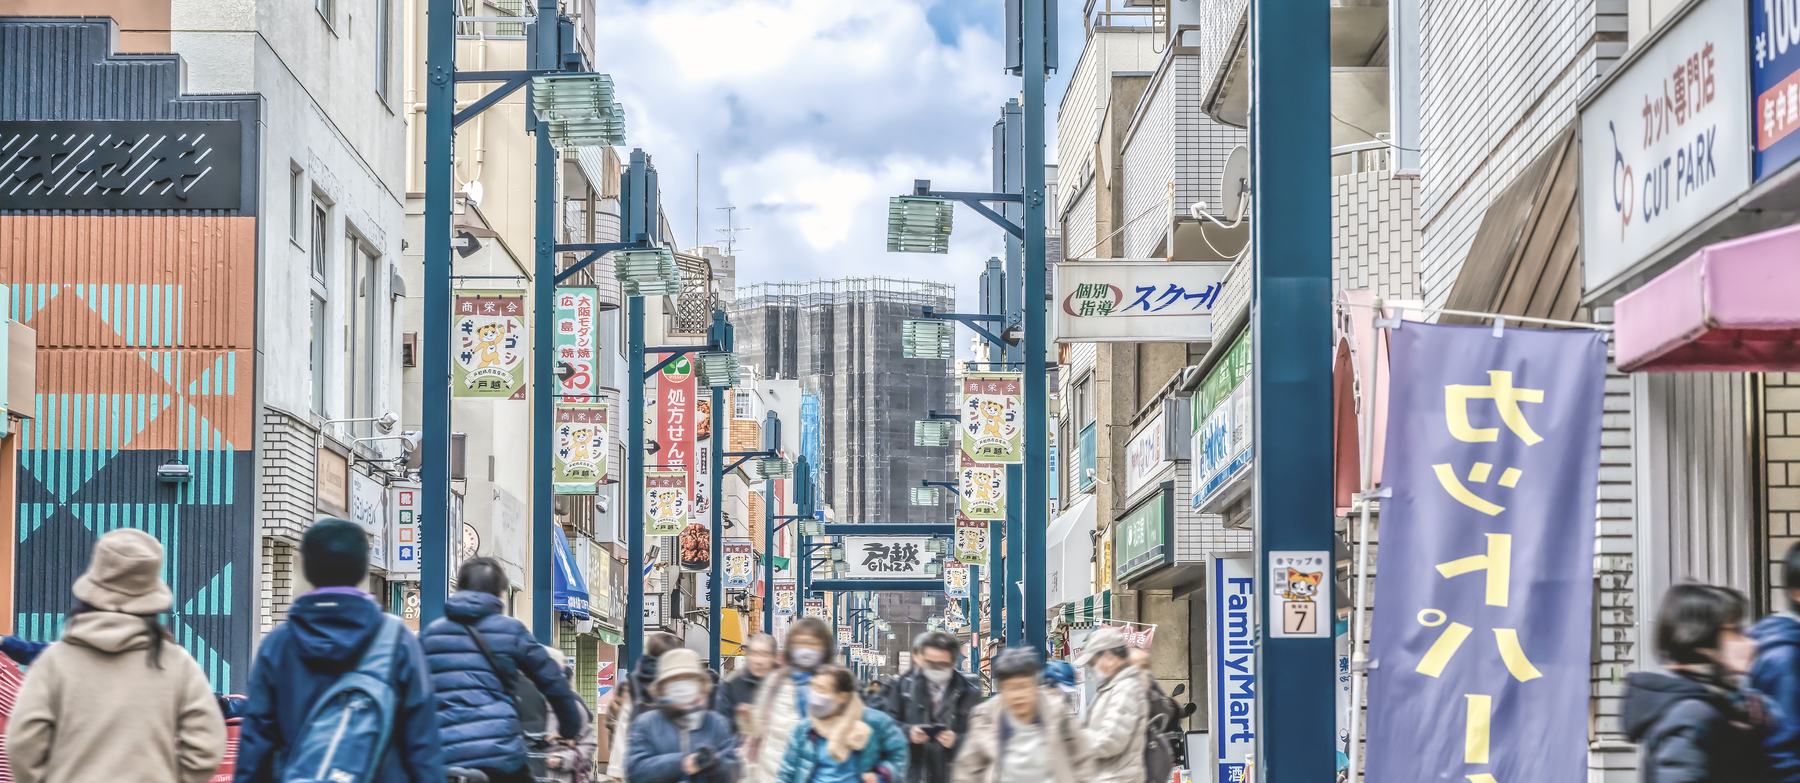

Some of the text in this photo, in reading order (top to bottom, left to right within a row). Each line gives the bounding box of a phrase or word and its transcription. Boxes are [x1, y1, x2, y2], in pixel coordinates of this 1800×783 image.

[1642, 41, 1715, 150] カット専門店
[1643, 124, 1716, 223] CUT PARK
[1075, 283, 1109, 299] 個別
[462, 301, 518, 312] 商栄会
[1079, 300, 1117, 317] 指導
[561, 296, 574, 358] 広島焼
[577, 296, 591, 358] 大阪モダン焼
[461, 319, 475, 365] ギンザ
[505, 319, 519, 365] トゴシ
[478, 380, 501, 389] 戸越
[969, 383, 1015, 392] 商栄会
[561, 412, 602, 420] 商栄会
[968, 397, 980, 434] ギンザ
[1005, 397, 1016, 435] トゴシ
[560, 425, 570, 459] ギンザ
[593, 426, 603, 459] トゴシ
[964, 469, 973, 498] ギンザ
[992, 469, 1001, 499] トゴシ
[650, 490, 658, 516] ギンザ
[676, 489, 684, 516] トゴシ
[861, 542, 920, 566] 戸越
[867, 559, 914, 572] GINZA
[1287, 557, 1312, 566] マップ
[1294, 611, 1307, 631] 7
[1225, 577, 1256, 744] FamilyMart
[1228, 765, 1243, 782] 酒
